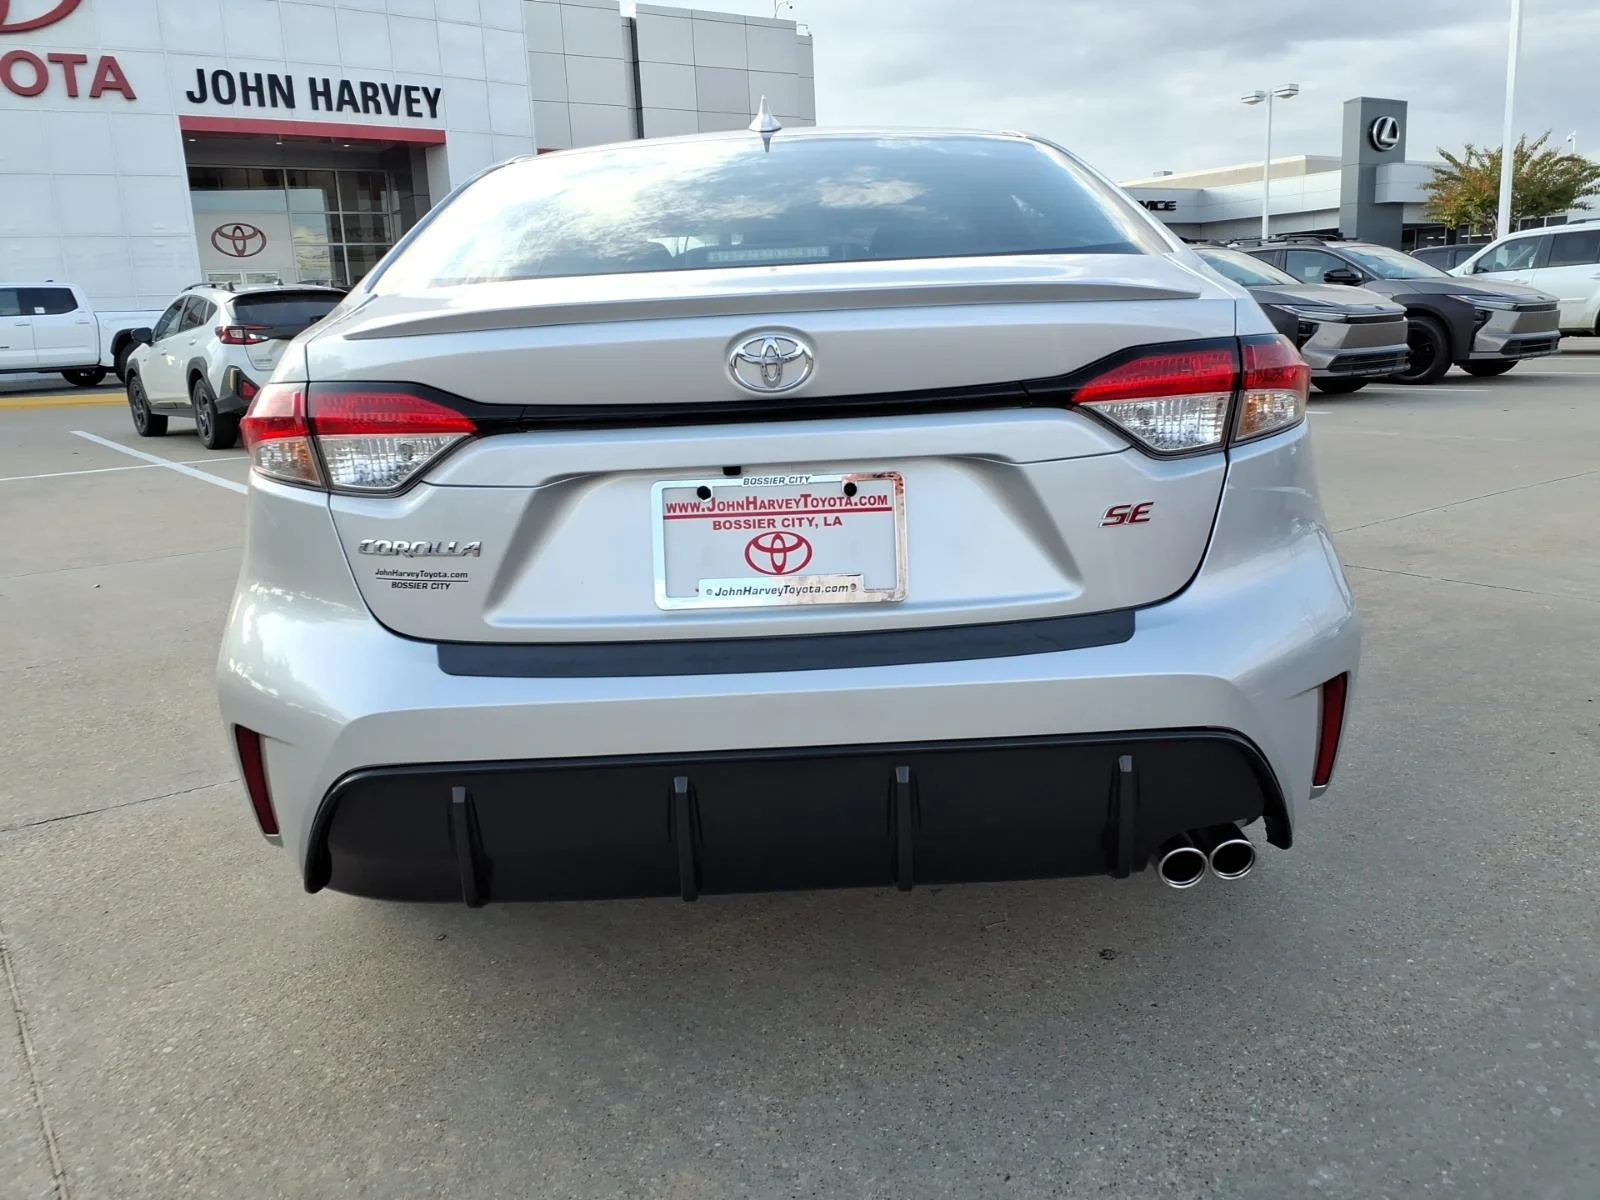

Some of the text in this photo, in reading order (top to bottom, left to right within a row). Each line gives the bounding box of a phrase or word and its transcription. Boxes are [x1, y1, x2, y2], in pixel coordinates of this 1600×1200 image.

[0, 49, 137, 100] OTA
[186, 68, 442, 119] JOHN HARVEY
[1137, 200, 1177, 211] VICE
[743, 475, 811, 486] BOSSIER CITY
[1100, 501, 1154, 527] SE
[712, 515, 843, 531] BOSSIER CITY, LA
[359, 539, 481, 557] COROLLA
[375, 568, 468, 579] JohnHarveyToyota.com
[391, 581, 451, 590] BOSSIER CITY
[714, 584, 849, 597] JohnHarveyToyota.com
